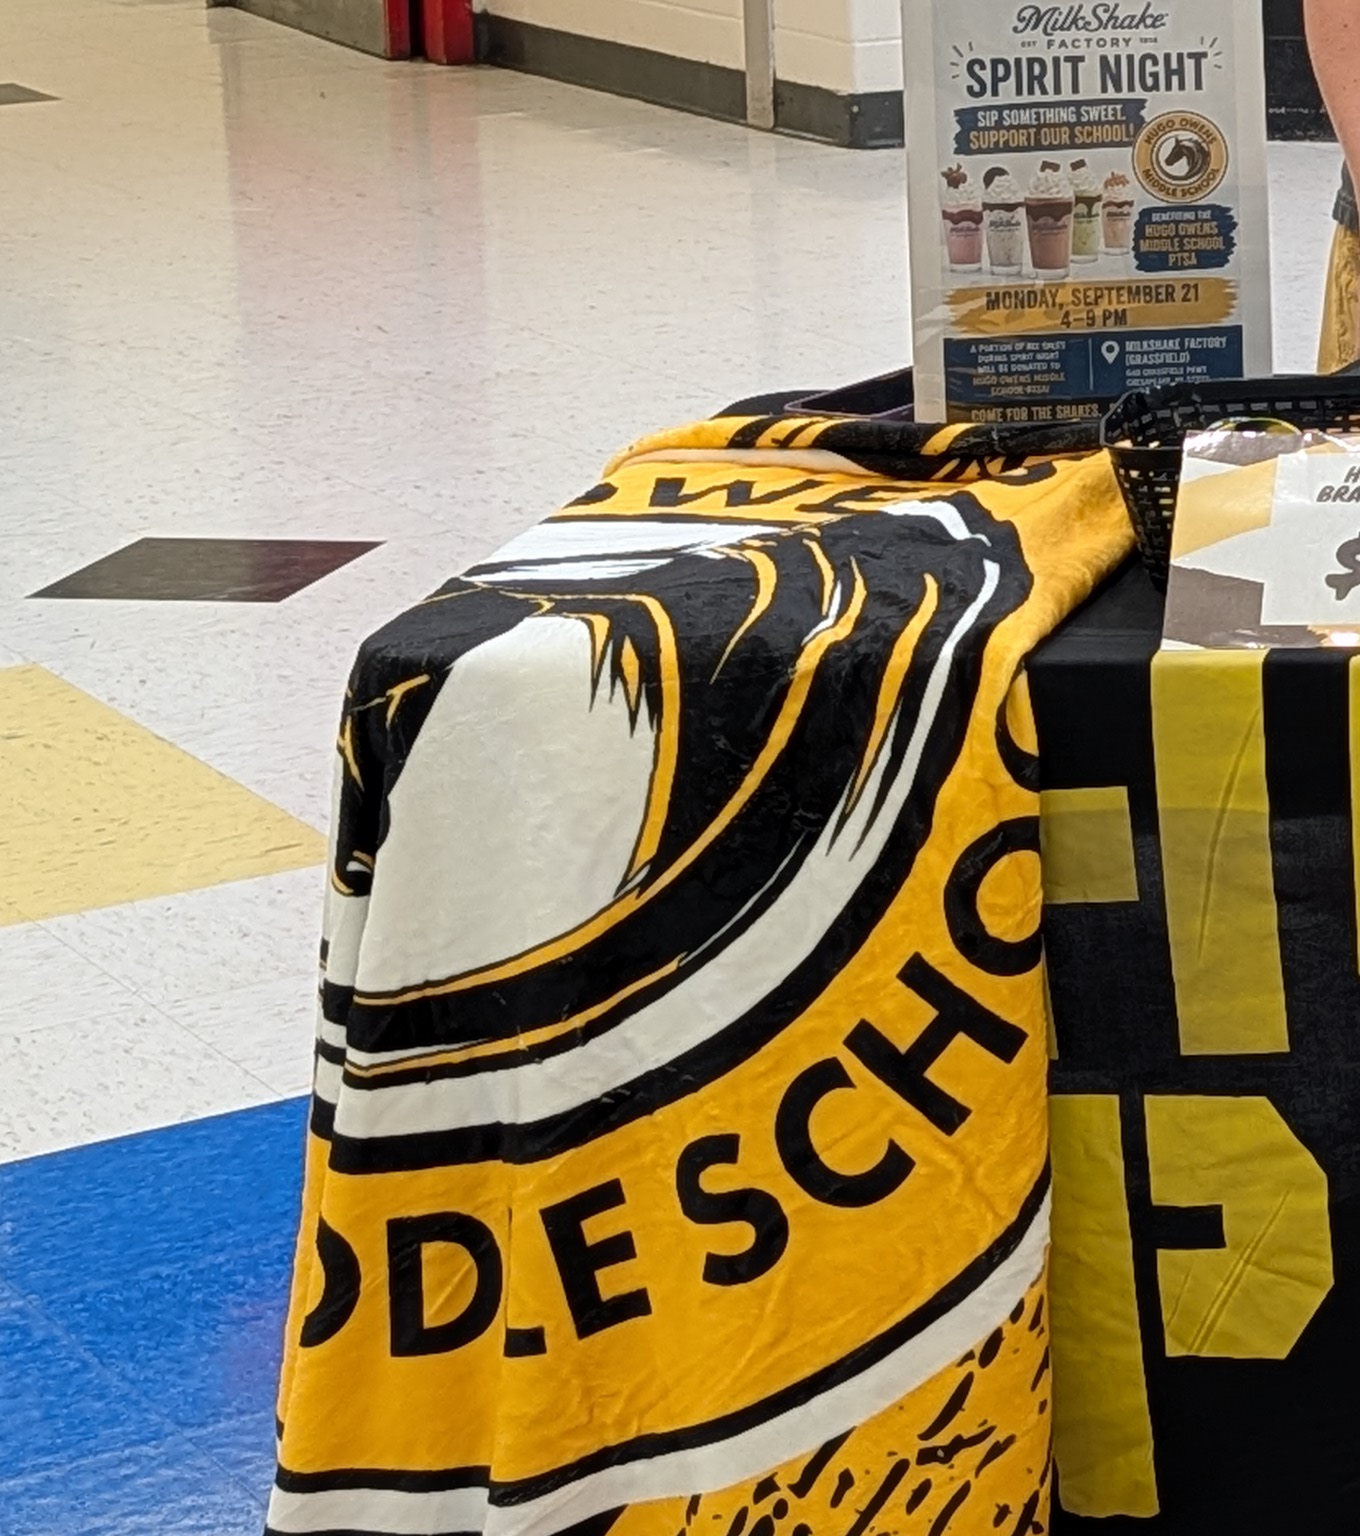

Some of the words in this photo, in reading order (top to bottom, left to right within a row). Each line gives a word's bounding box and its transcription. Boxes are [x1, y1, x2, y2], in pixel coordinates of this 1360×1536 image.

[1012, 2, 1168, 37] MilkShake
[1047, 37, 1132, 50] FACTORY
[966, 54, 1085, 98] SPIRIT
[1099, 51, 1209, 94] NIGHT
[977, 110, 999, 127] SIP
[1002, 107, 1077, 127] SOMETHING
[969, 127, 1037, 150] SUPPORT
[1040, 125, 1070, 146] OUR
[1074, 123, 1135, 144] SCHOOL!
[1144, 119, 1176, 145] HUGO
[1145, 224, 1176, 237] HUGO
[1168, 252, 1198, 266] PTSA
[986, 290, 1064, 311] MONDAY,
[1071, 285, 1176, 308] SEPTEMBER
[1181, 283, 1200, 303] 21
[1102, 309, 1129, 327] PM
[1006, 407, 1028, 421] FOR
[1031, 406, 1054, 420] THE
